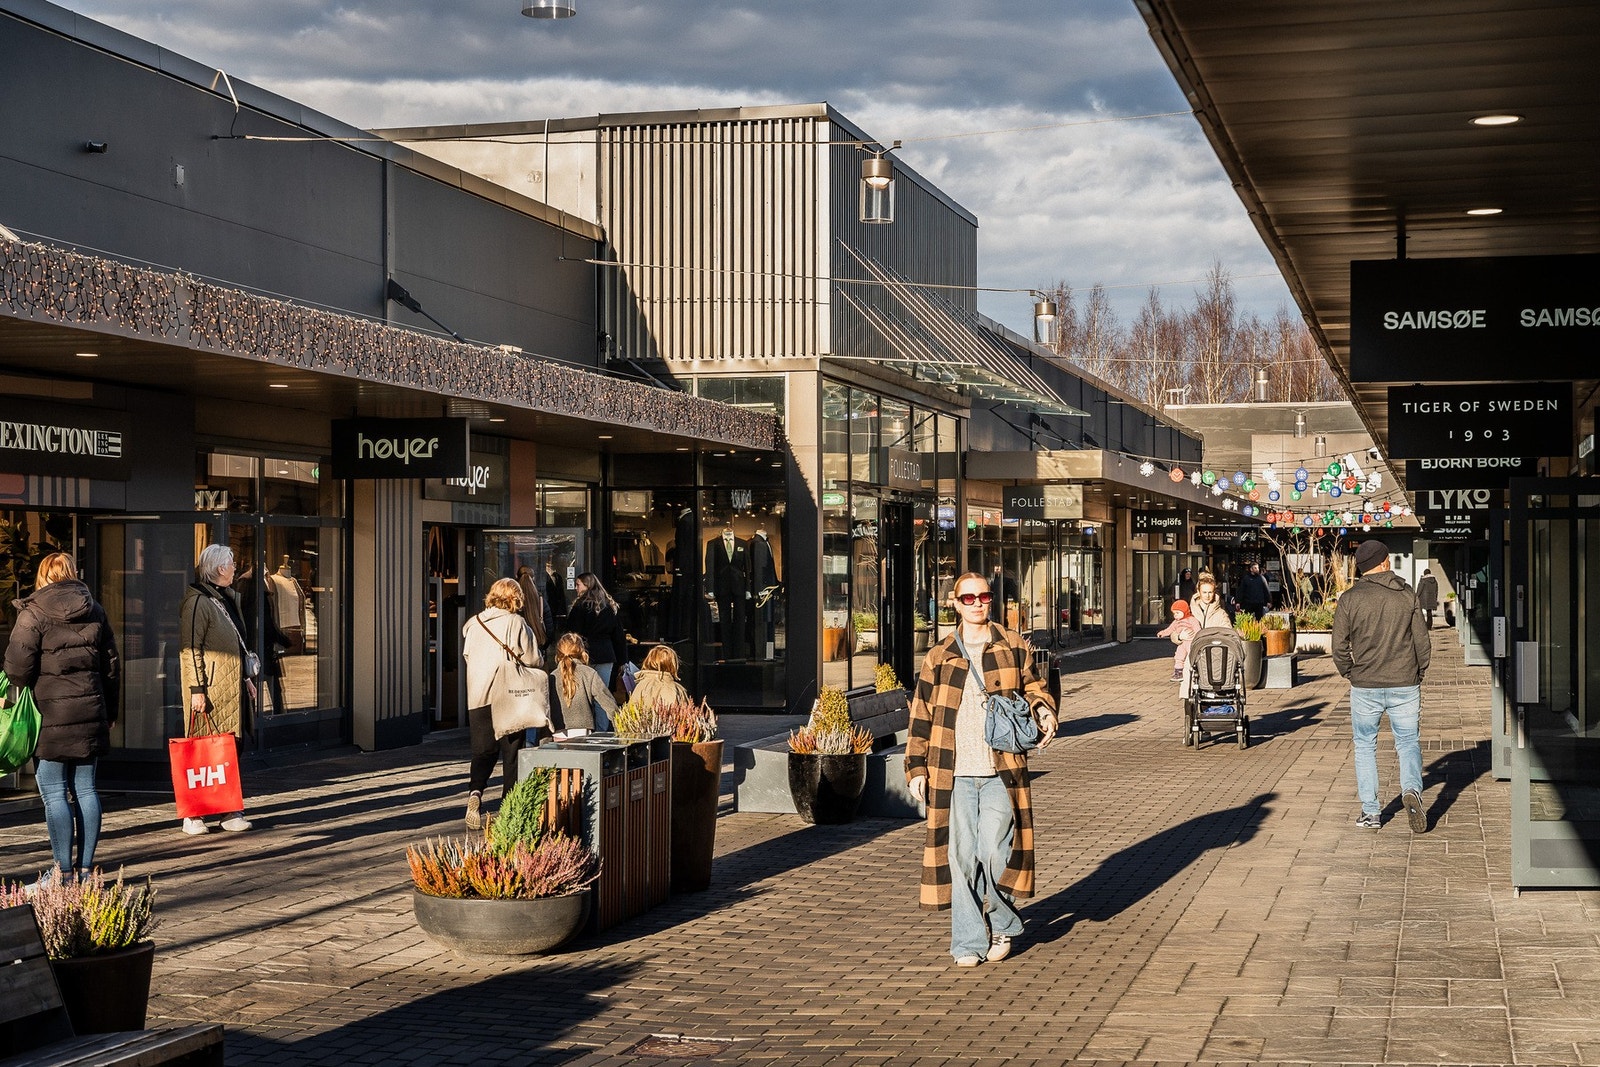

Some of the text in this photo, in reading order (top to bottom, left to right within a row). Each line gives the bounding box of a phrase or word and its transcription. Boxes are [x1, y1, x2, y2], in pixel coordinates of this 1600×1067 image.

[1384, 309, 1486, 329] SAMSØE
[1403, 399, 1558, 414] TIGER OF SWEDEN
[1477, 457, 1521, 468] BORG
[1011, 497, 1073, 508] FOLLESTAD
[1428, 489, 1491, 509] LYKO
[1150, 517, 1182, 528] Haglöfs
[187, 764, 226, 789] HH
